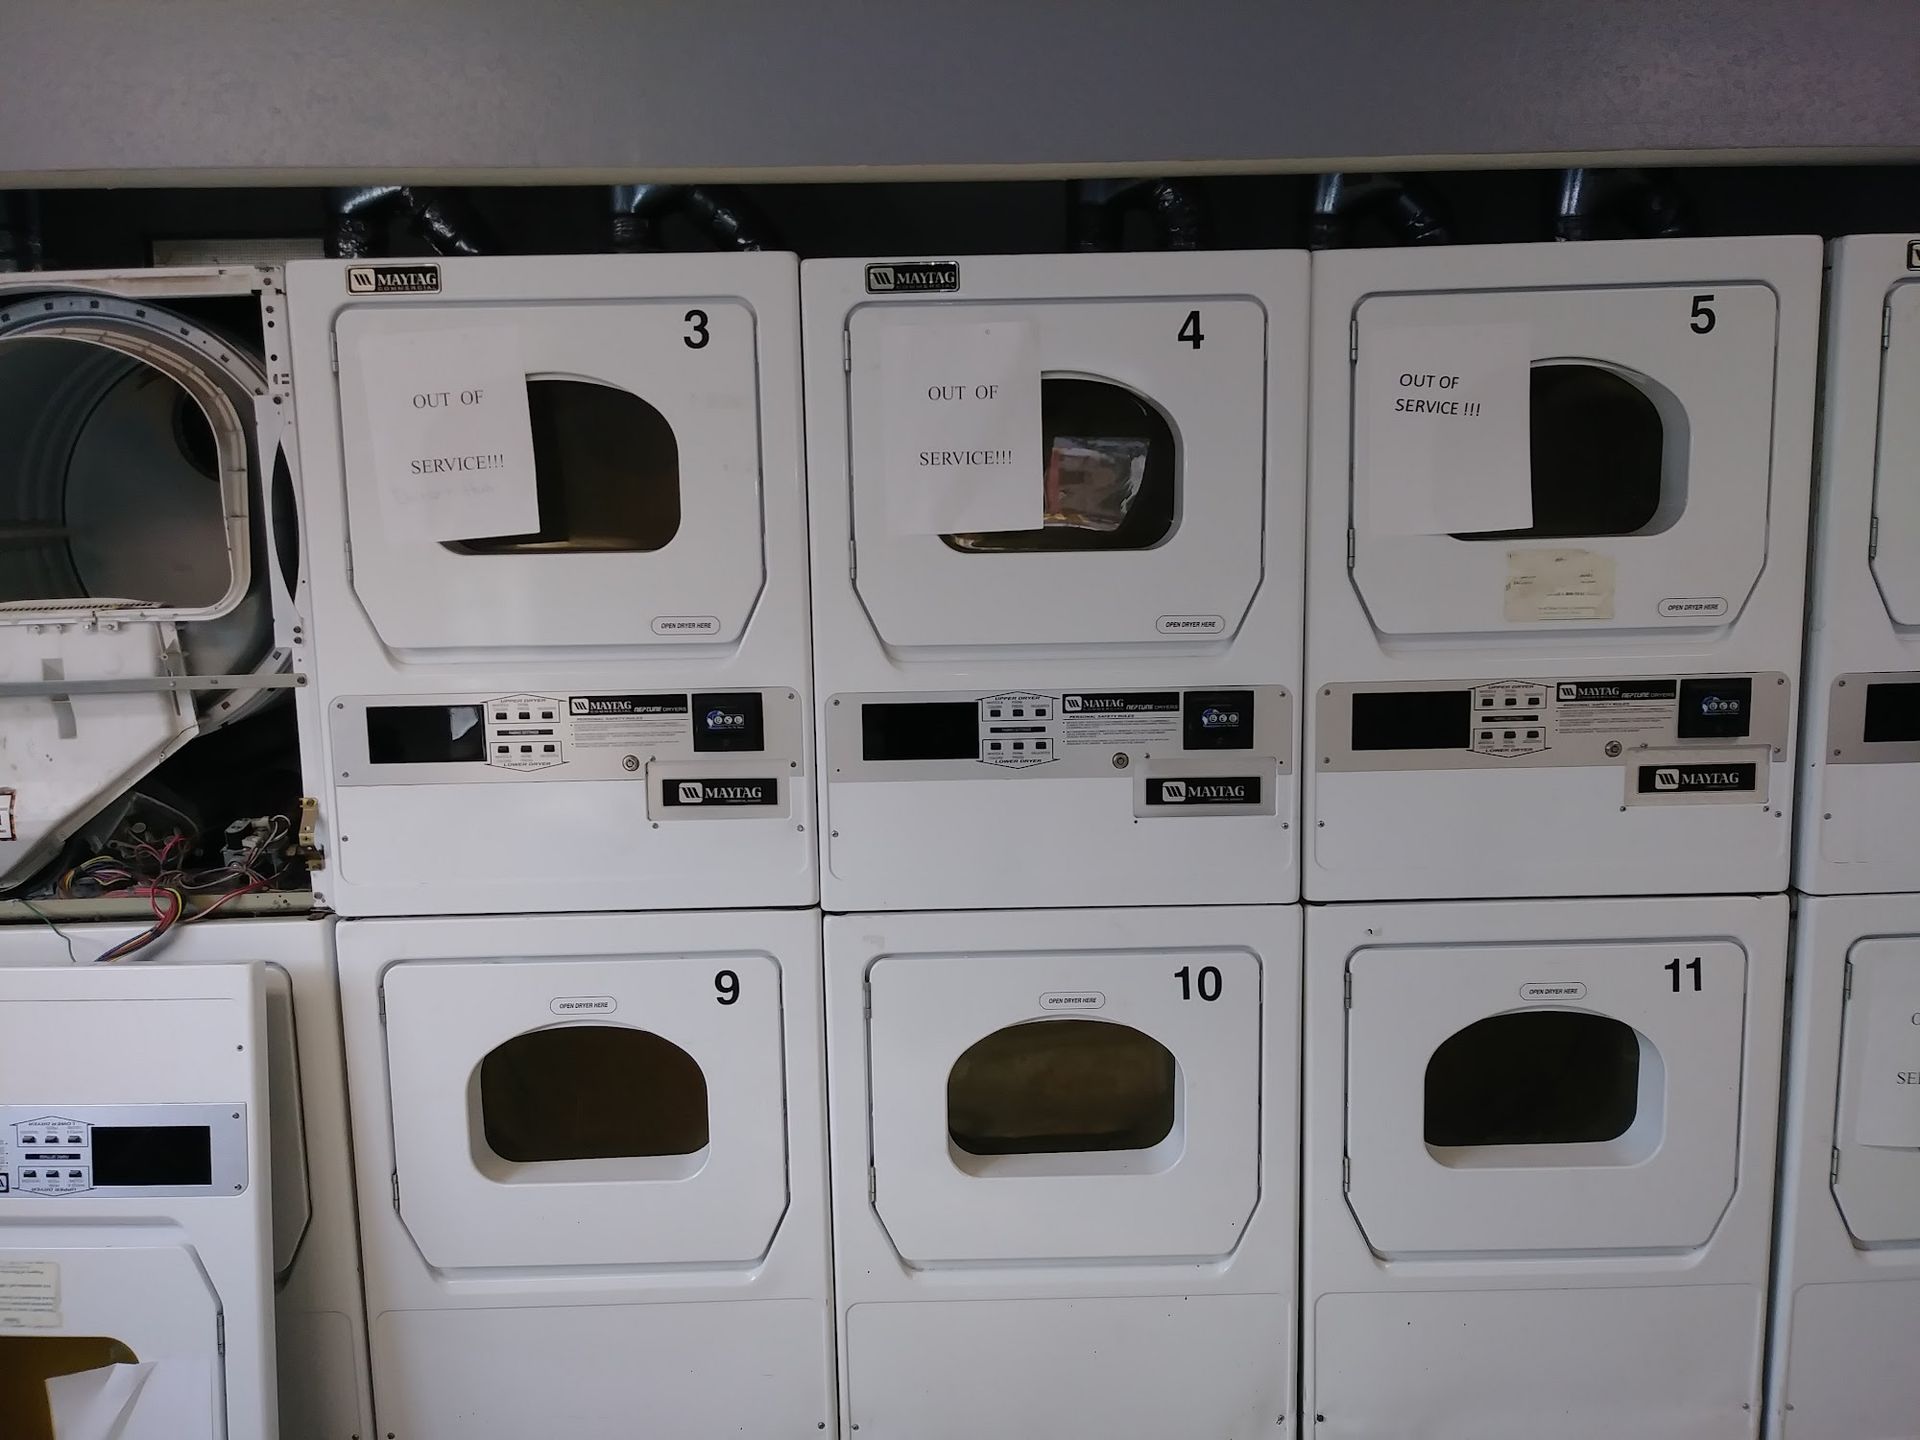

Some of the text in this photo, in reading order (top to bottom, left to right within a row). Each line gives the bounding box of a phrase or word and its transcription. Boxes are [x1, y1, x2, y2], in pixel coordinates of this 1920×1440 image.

[377, 273, 436, 286] MAYTAG
[896, 271, 955, 284] MAYTAG
[1691, 295, 1716, 334] 5
[684, 310, 709, 349] 3
[1178, 311, 1205, 349] 4
[1399, 373, 1460, 389] OUT OF
[413, 390, 484, 409] OUT OF
[928, 385, 999, 401] OUT OF
[1395, 398, 1481, 417] SERVICE !!!
[411, 454, 504, 475] SERVICE!!!
[919, 450, 1012, 466] SERVICE!!!
[1578, 687, 1620, 696] MAYTAG
[590, 701, 632, 710] MAYTAG
[1083, 699, 1124, 708] MAYTAG
[1681, 772, 1739, 785] MAYTAG
[704, 787, 762, 799] MAYTAG
[1188, 785, 1245, 797] MAYTAG
[1665, 958, 1702, 992] 11
[715, 970, 740, 1006] 9
[1175, 967, 1222, 1001] 10
